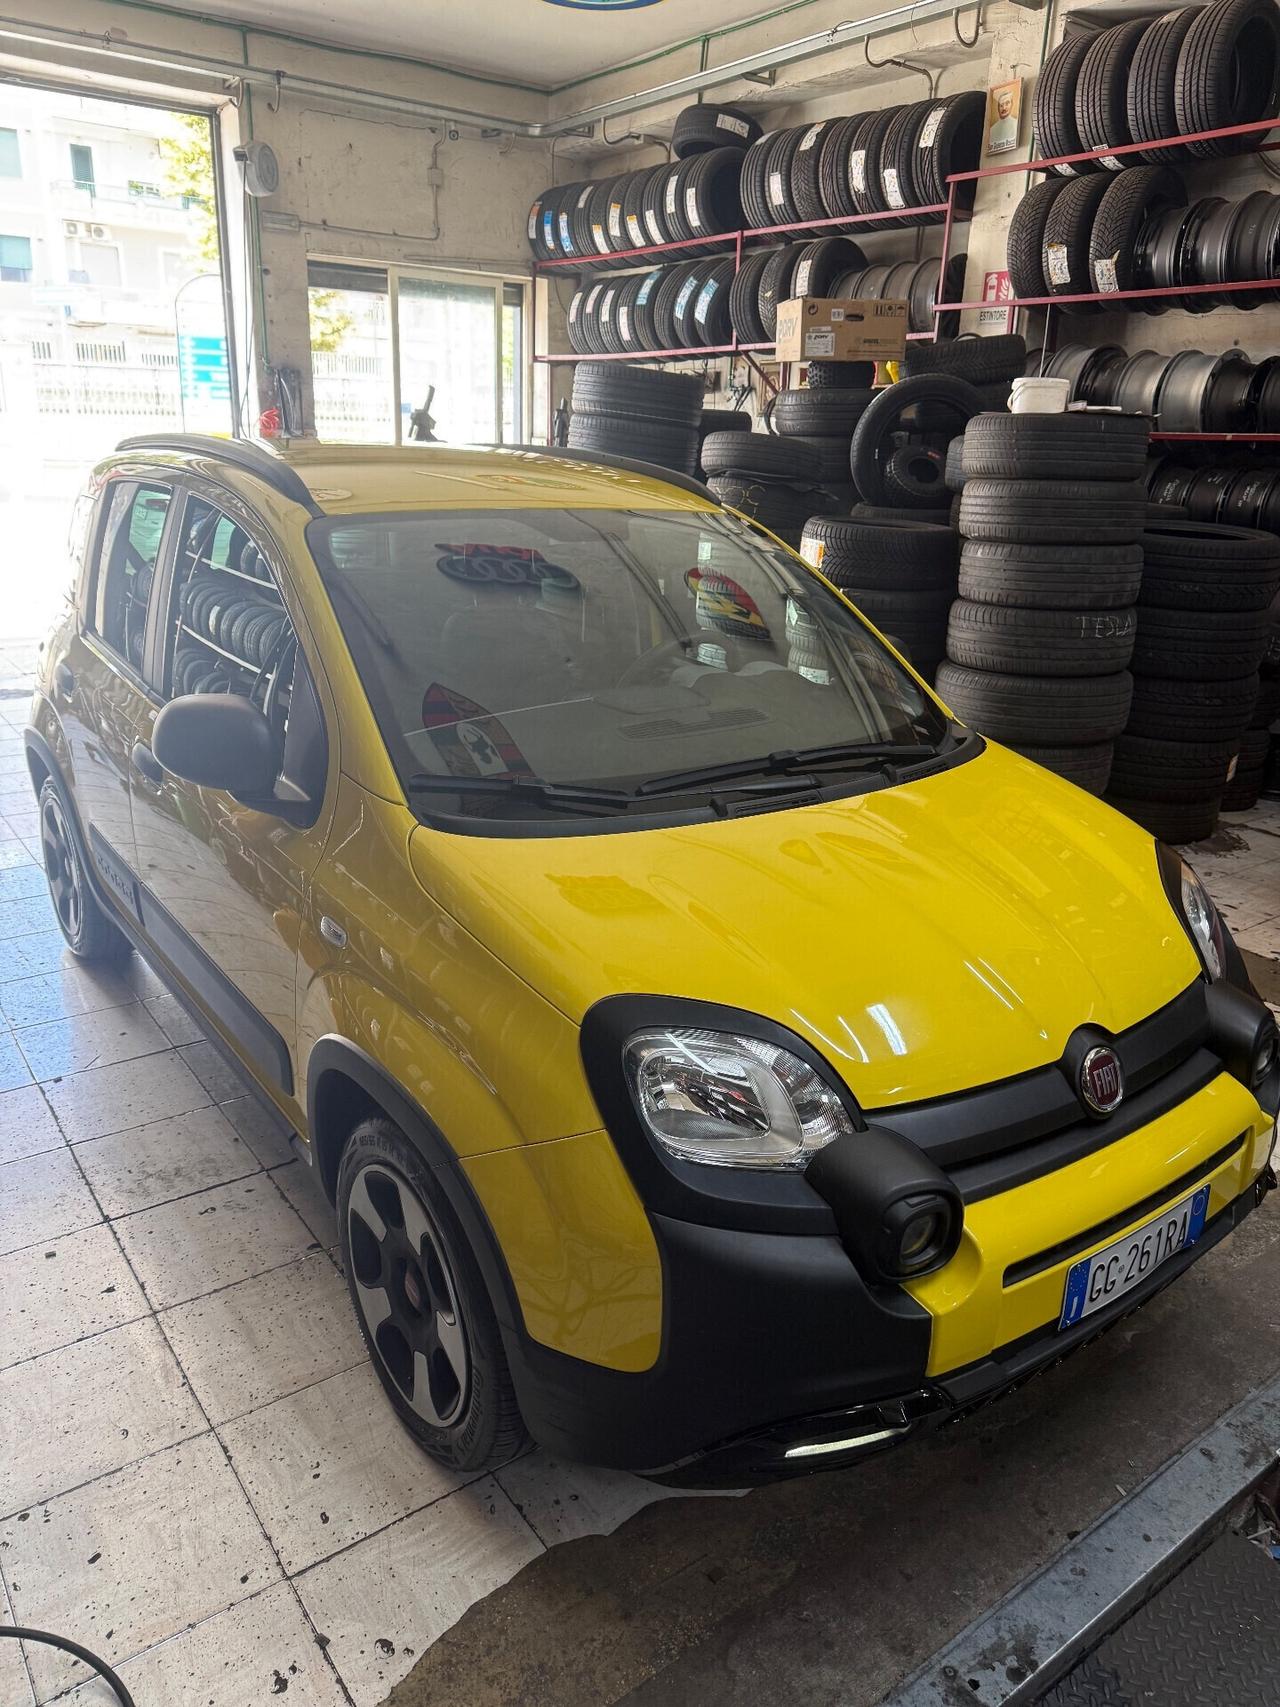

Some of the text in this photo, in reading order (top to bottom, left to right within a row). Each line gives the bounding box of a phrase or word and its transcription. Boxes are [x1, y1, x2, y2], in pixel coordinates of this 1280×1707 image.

[980, 310, 1007, 321] ESTINTORE
[1093, 1063, 1117, 1098] FIAT
[1088, 1209, 1188, 1303] GG 261RA
